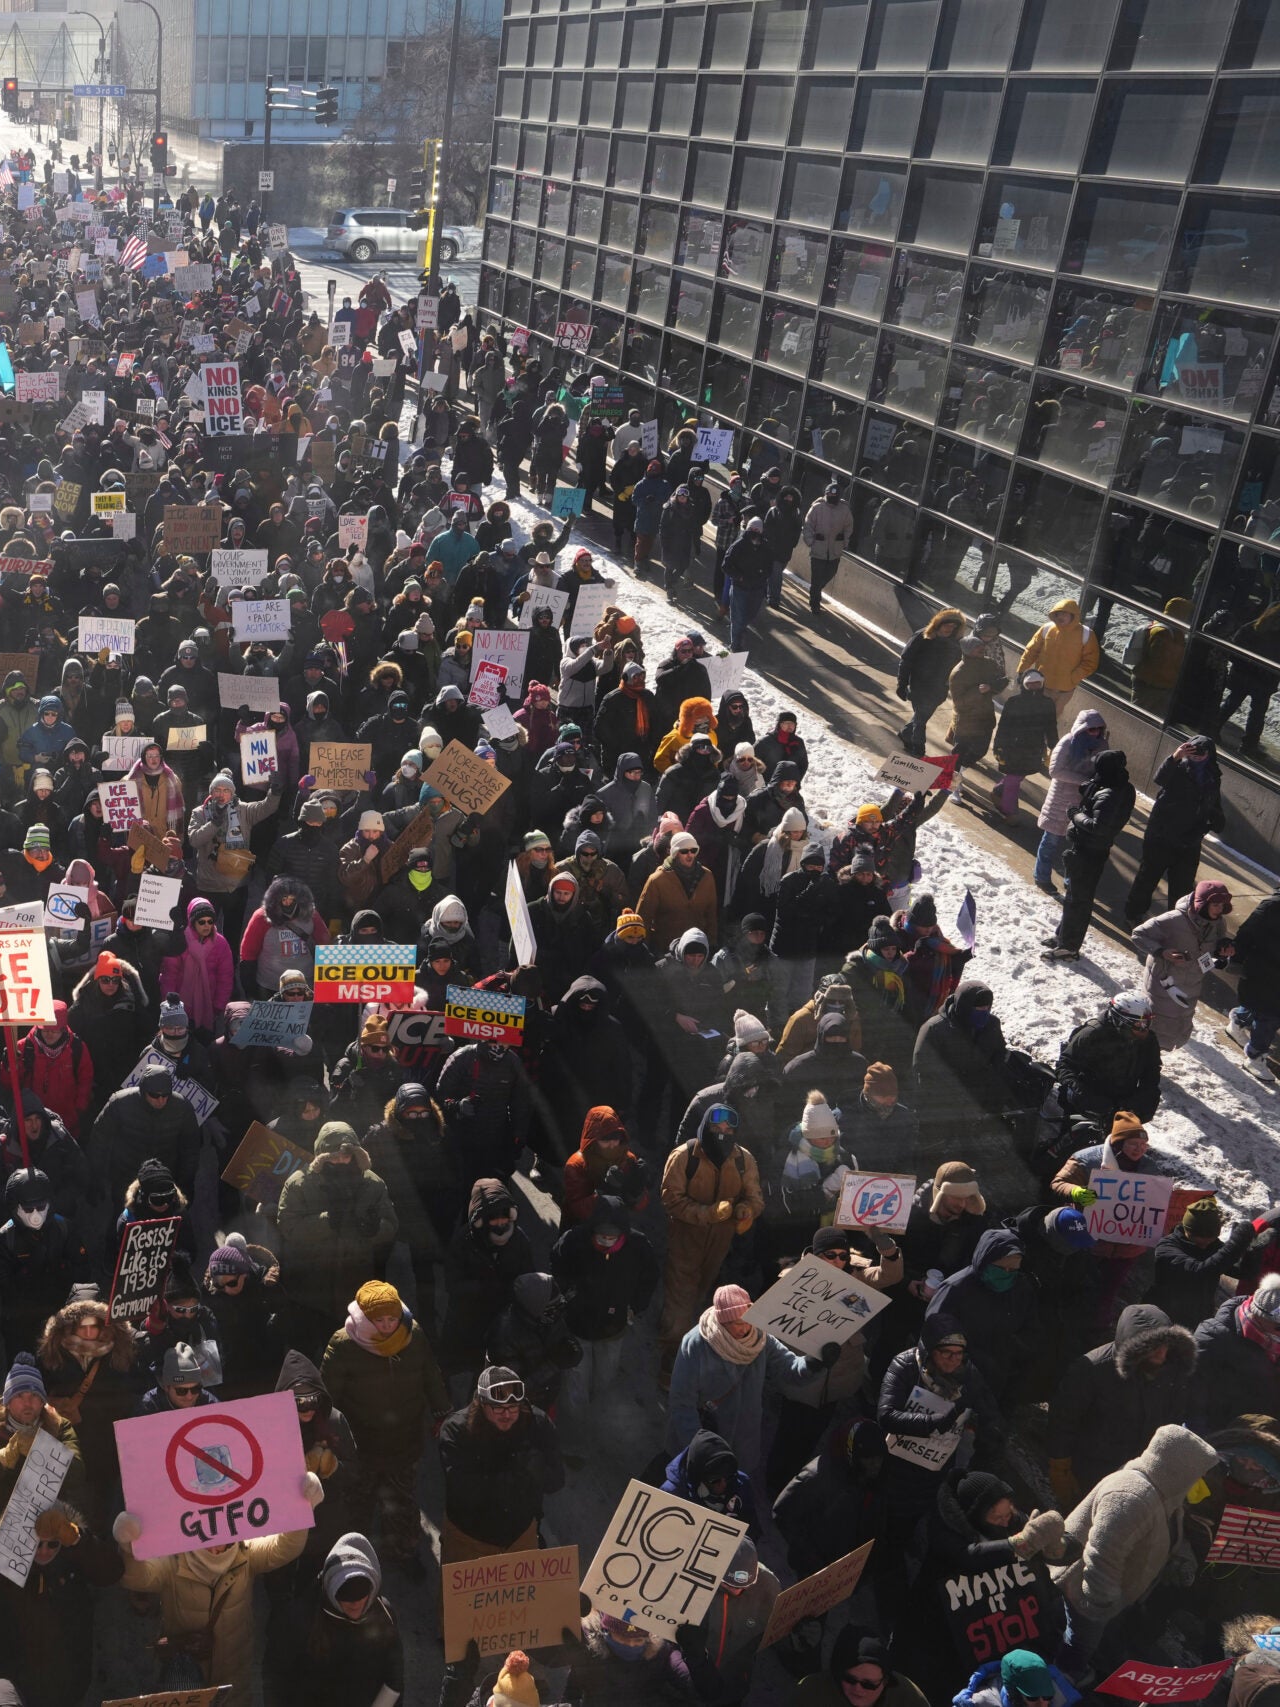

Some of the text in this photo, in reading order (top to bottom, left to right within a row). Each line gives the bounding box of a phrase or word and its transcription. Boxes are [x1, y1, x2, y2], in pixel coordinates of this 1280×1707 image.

[342, 354, 355, 366] 84
[206, 366, 237, 386] NO
[208, 386, 237, 397] KINGS
[209, 398, 239, 416] NO
[210, 416, 241, 432] ICE
[340, 517, 355, 526] LOVE
[476, 631, 524, 648] NO MORE
[251, 740, 267, 756] MN
[318, 749, 364, 761] RELEASE
[314, 767, 366, 780] TRUMPSTEIN
[446, 747, 504, 792] MORE PUGS
[890, 755, 924, 773] Families
[327, 779, 353, 787] FILES
[446, 763, 496, 801] LESS ICE
[880, 770, 911, 786] Together
[436, 772, 484, 810] THUGS
[16, 912, 35, 922] FOR
[13, 939, 32, 948] SAY
[317, 966, 414, 981] ICE OUT
[337, 984, 391, 1000] MSP
[253, 1003, 291, 1018] PROTECT
[446, 1004, 522, 1028] ICE OUT
[287, 1024, 305, 1034] NOT
[462, 1022, 505, 1038] MSP
[1100, 1178, 1146, 1203] ICE
[858, 1190, 898, 1218] ICE
[1114, 1203, 1165, 1224] OUT
[1088, 1209, 1154, 1237] NOW!!!
[126, 1221, 174, 1250] Resist
[149, 1250, 167, 1271] its
[123, 1269, 157, 1292] 1938
[792, 1267, 840, 1302] PLOW
[111, 1294, 156, 1320] Germany
[780, 1291, 854, 1331] ICE OUT
[180, 1497, 270, 1544] GTFO
[618, 1492, 742, 1585] ICE
[452, 1555, 571, 1590] SHAME ON YOU
[595, 1582, 630, 1606] for
[602, 1552, 717, 1616] OUT
[944, 1563, 1034, 1610] MAKE
[474, 1584, 536, 1610] EMMER
[988, 1593, 1006, 1614] IT
[472, 1609, 527, 1630] NOEM
[967, 1597, 1040, 1657] STOP
[1122, 1669, 1221, 1687] ABOLISH
[1143, 1684, 1180, 1698] ICE
